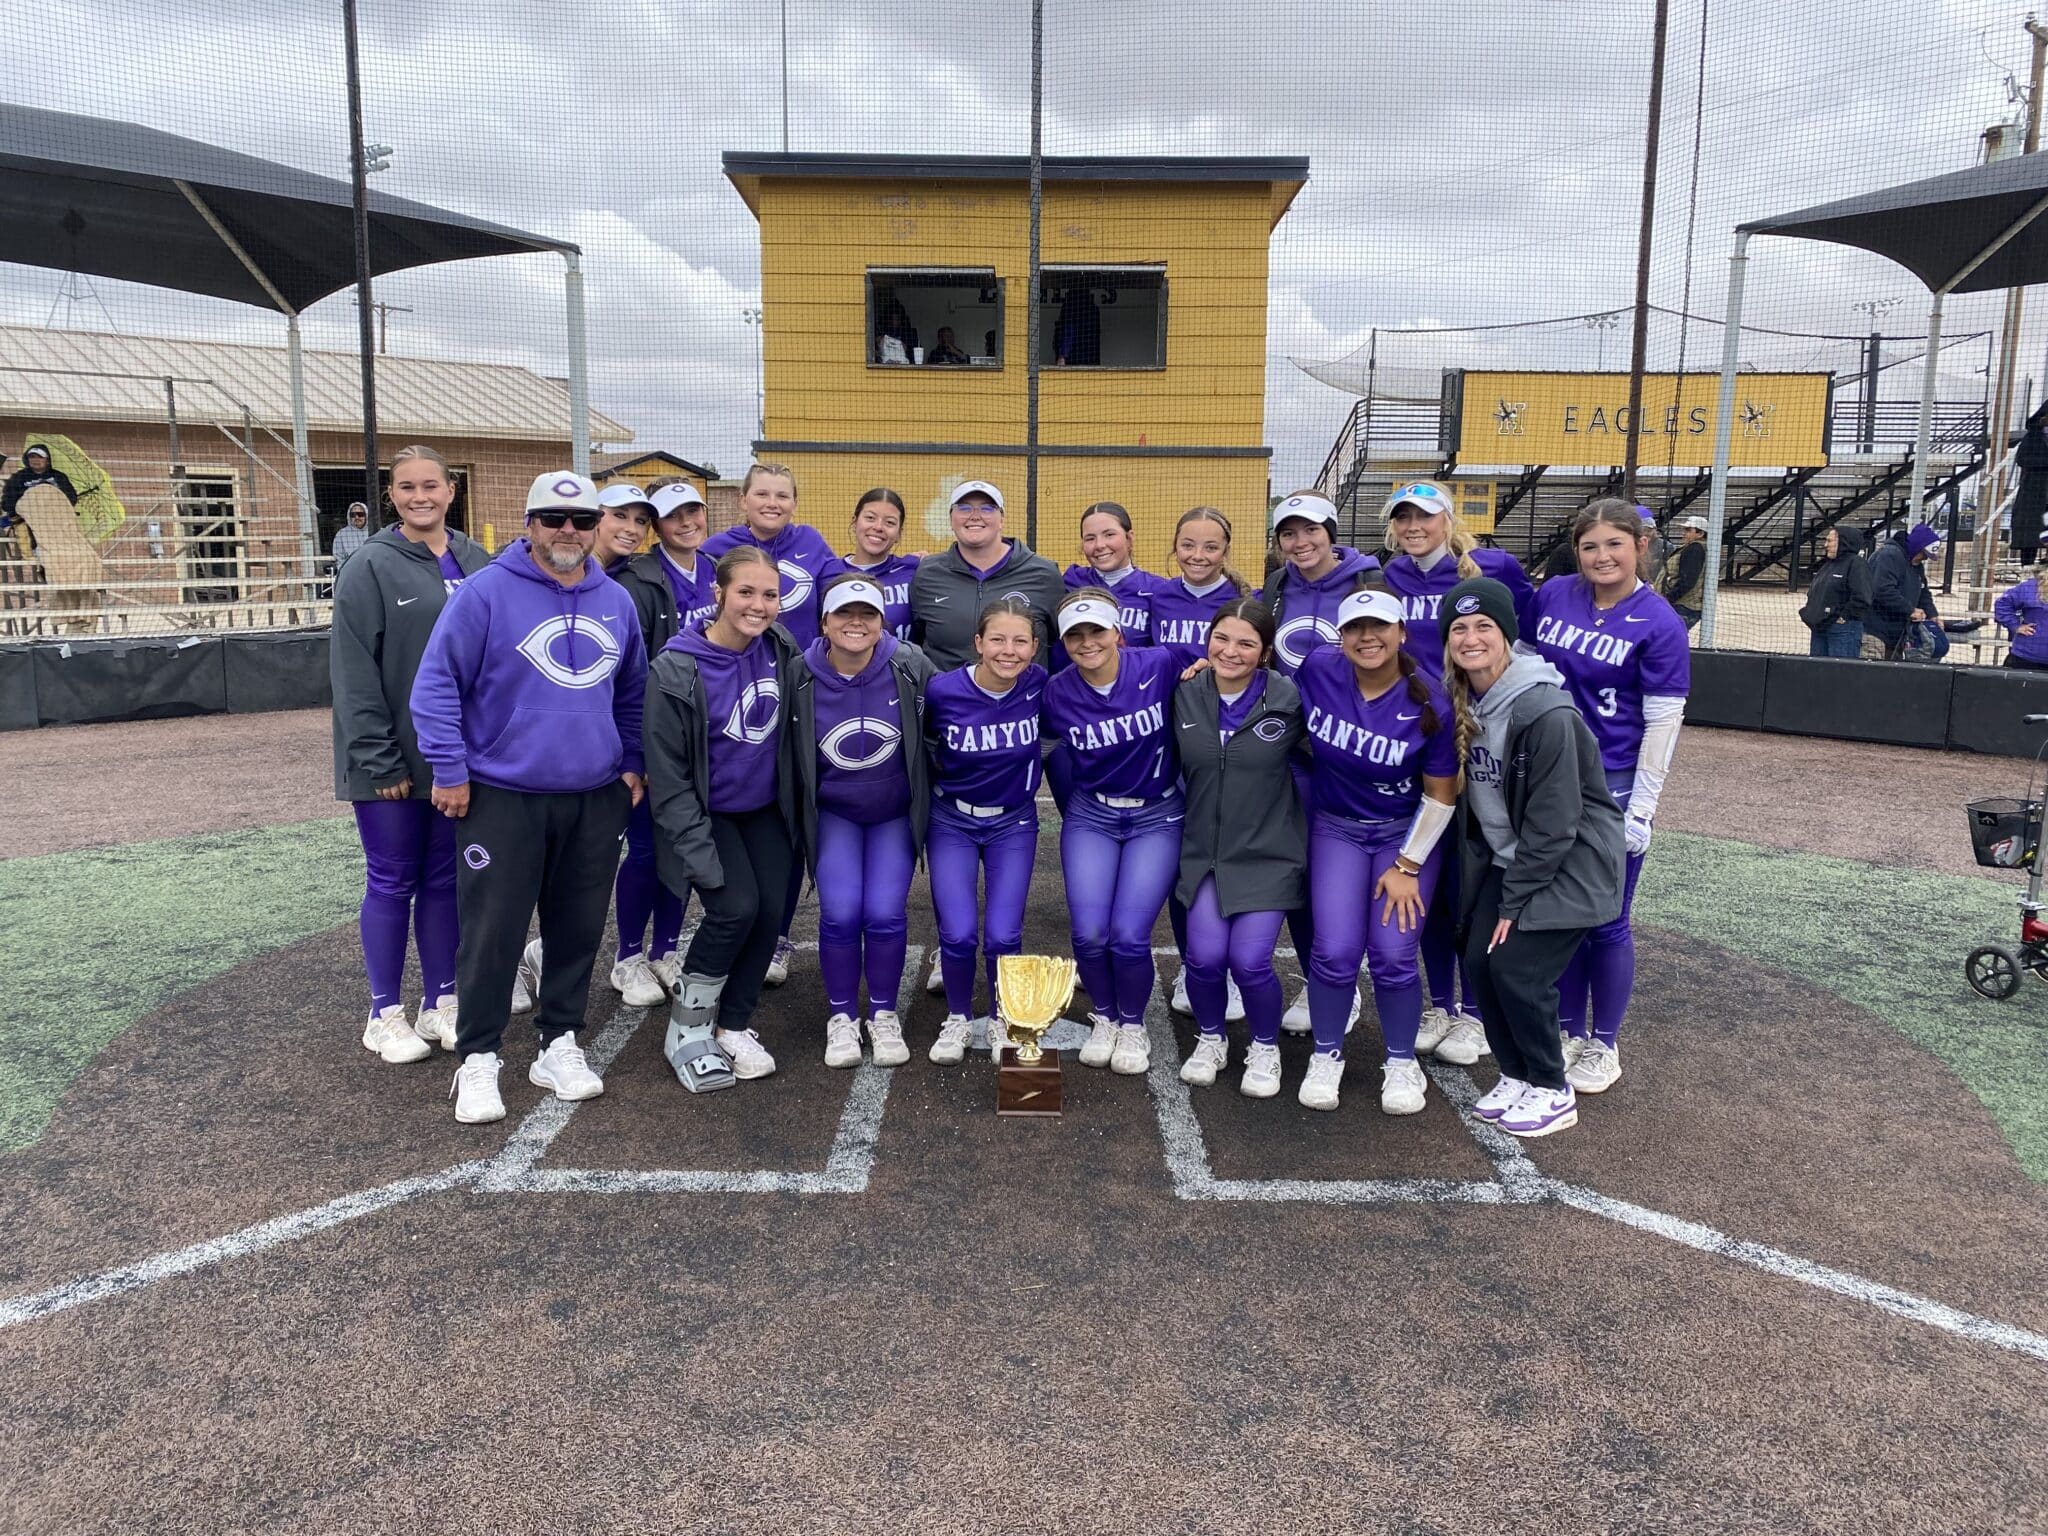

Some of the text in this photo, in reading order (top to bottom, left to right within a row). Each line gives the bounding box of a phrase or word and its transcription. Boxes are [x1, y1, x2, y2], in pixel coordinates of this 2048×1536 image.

[1564, 406, 1707, 435] EAGLES
[1160, 619, 1212, 645] CANY
[1537, 616, 1633, 667] CANYON
[516, 614, 621, 690] C
[1597, 687, 1618, 717] 3
[818, 717, 902, 771] C
[947, 713, 1039, 752] CANYON
[1069, 702, 1165, 751] CANYON
[1307, 705, 1409, 767] CANYON
[1025, 759, 1034, 791] 1
[1152, 746, 1165, 779] 7
